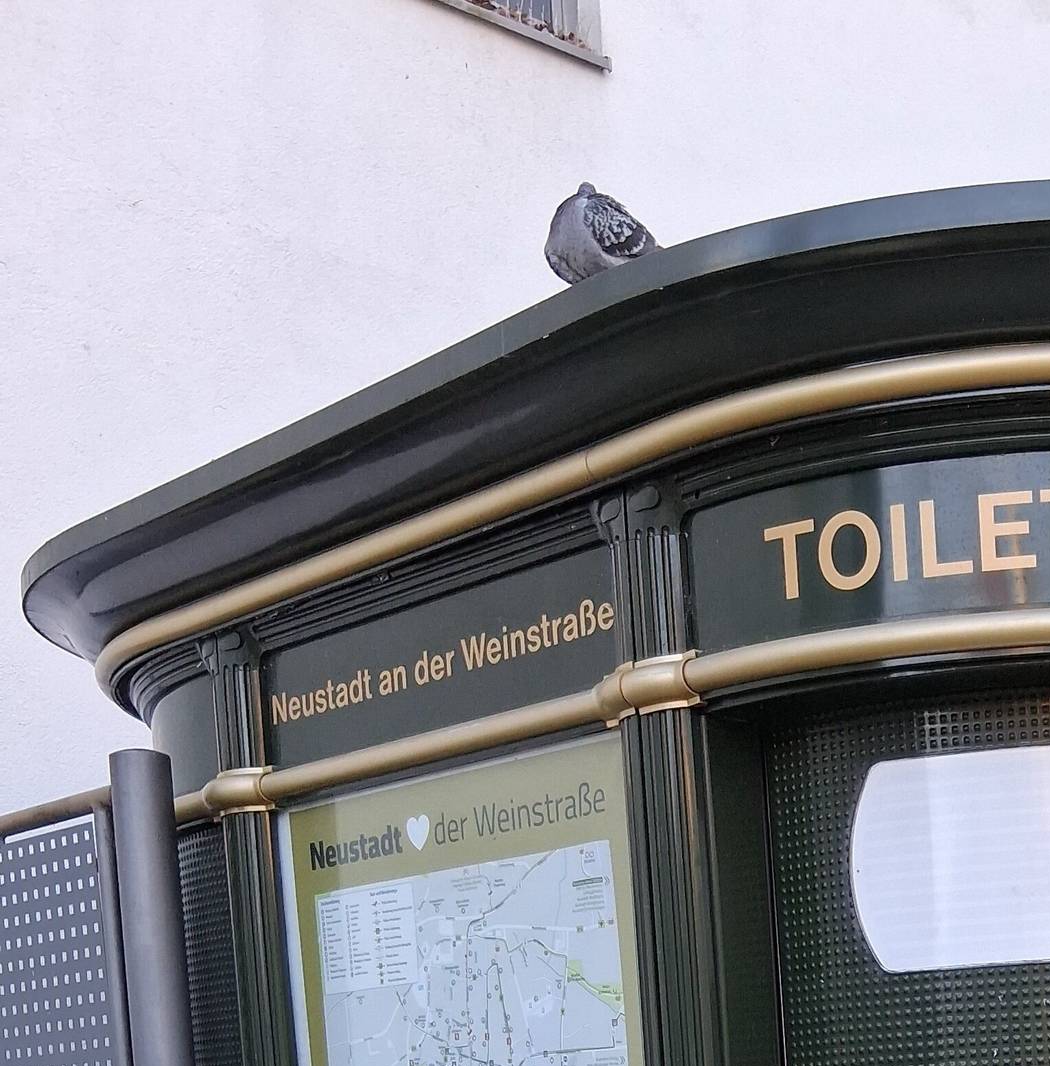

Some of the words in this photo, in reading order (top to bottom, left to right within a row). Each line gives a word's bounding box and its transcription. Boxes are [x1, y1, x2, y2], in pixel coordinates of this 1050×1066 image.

[271, 668, 374, 726] Neustadt
[378, 665, 408, 697] an
[414, 650, 456, 687] der
[460, 598, 615, 672] Weinstraße
[309, 824, 404, 871] Neustadt
[434, 812, 468, 846] der
[473, 781, 606, 838] Weinstraße
